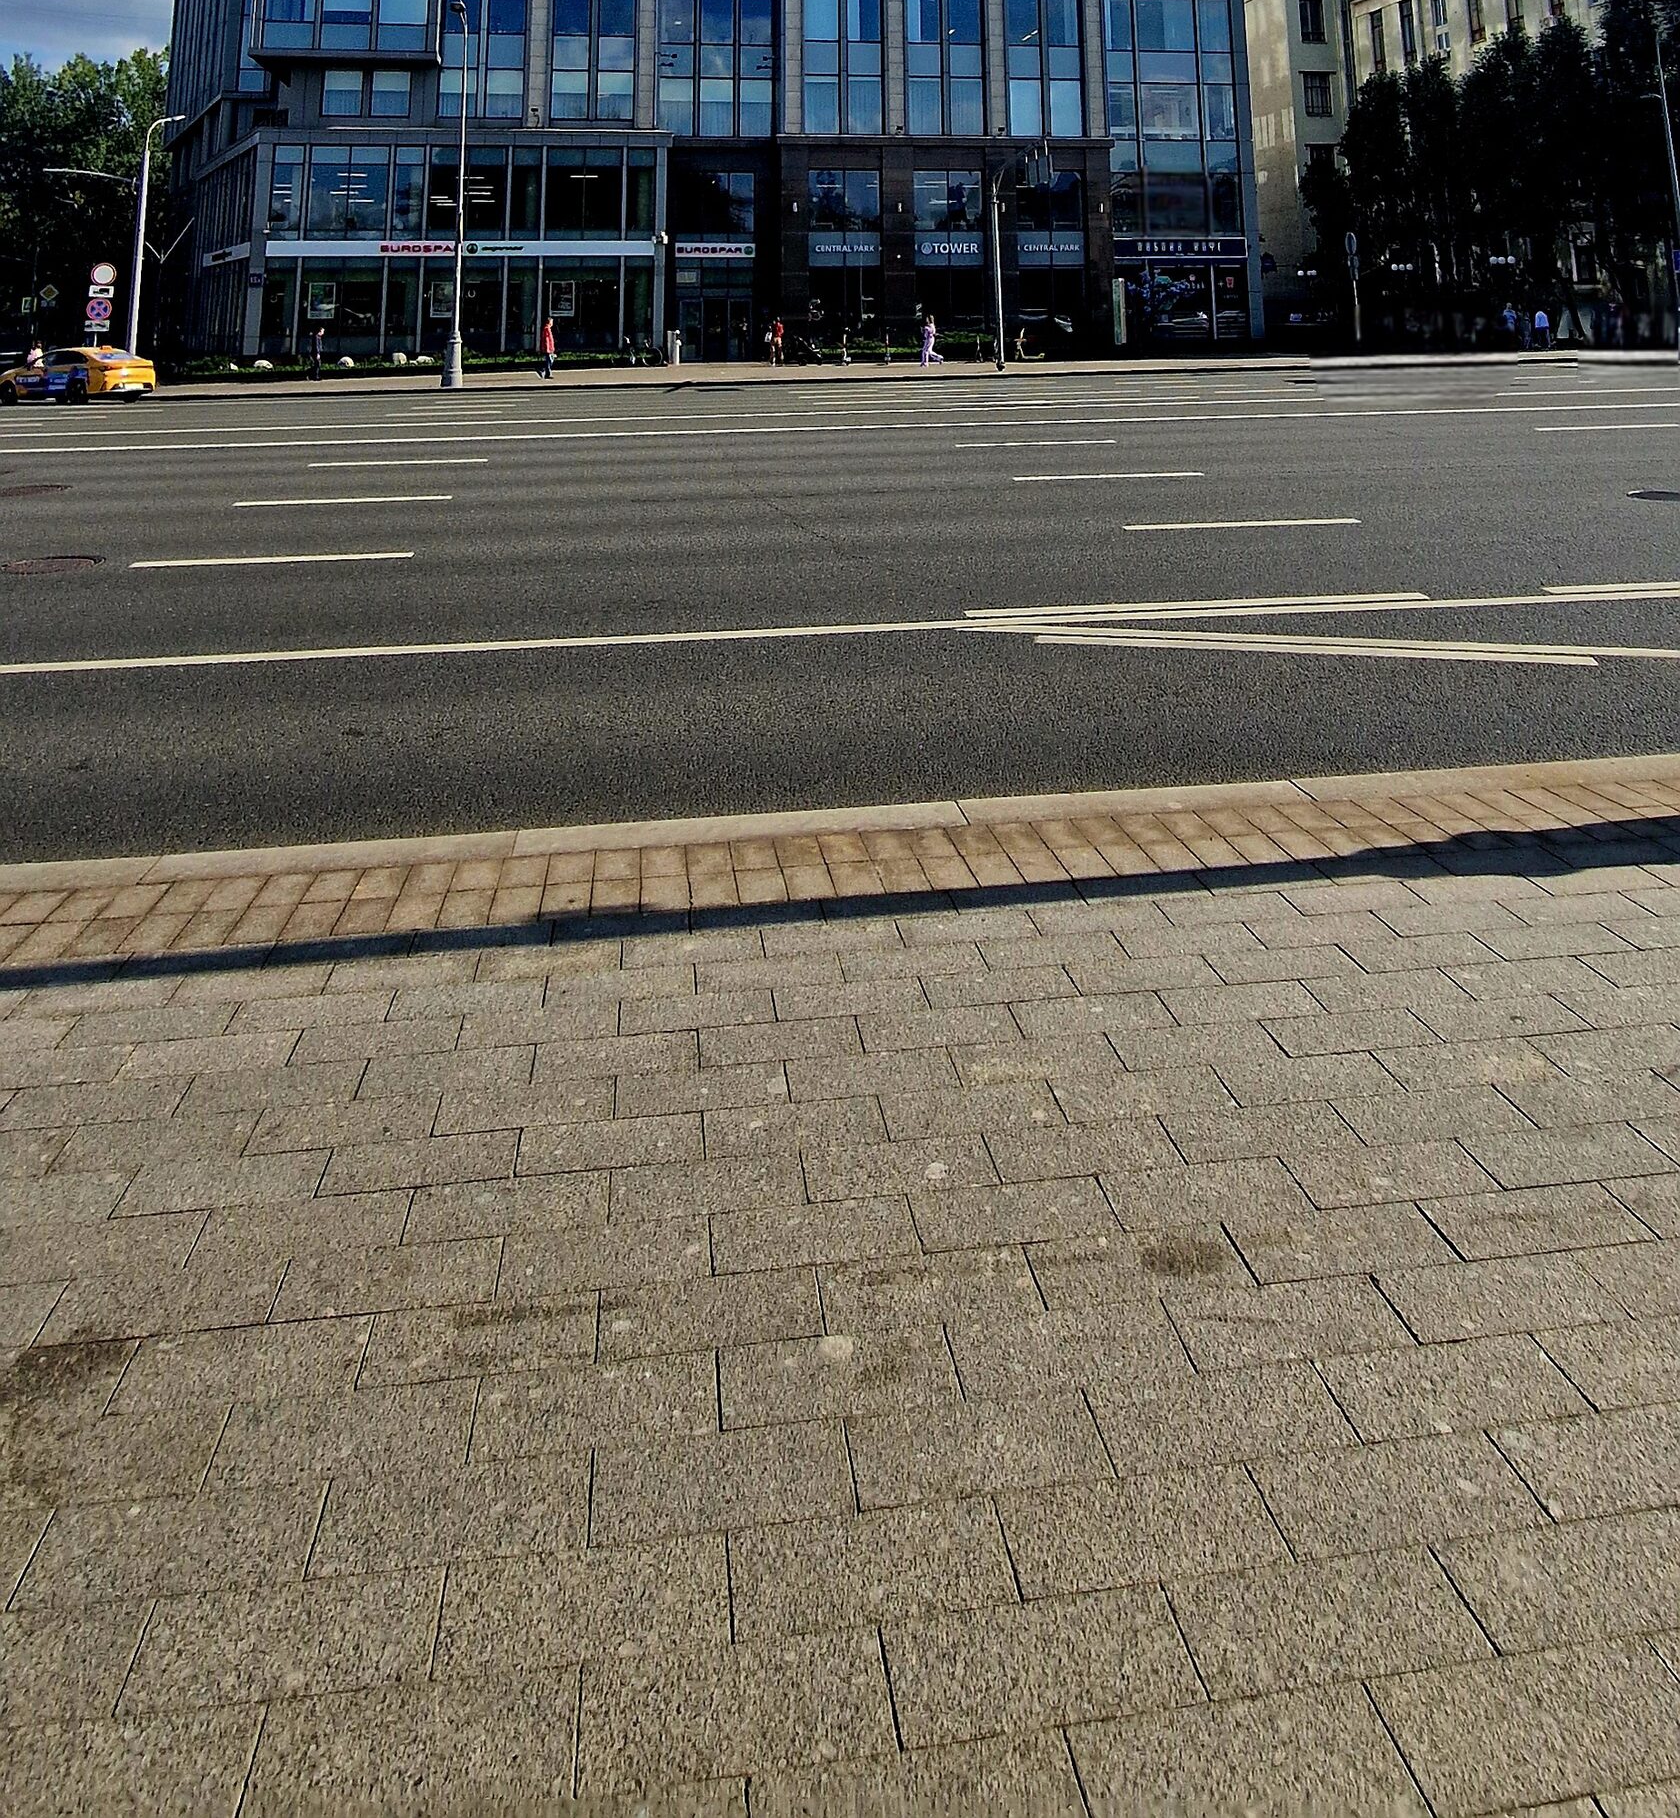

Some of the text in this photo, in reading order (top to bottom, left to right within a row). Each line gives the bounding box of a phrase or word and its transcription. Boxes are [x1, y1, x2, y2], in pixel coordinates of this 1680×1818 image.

[676, 246, 743, 254] EUROSPAR
[932, 243, 979, 254] TOWER
[1023, 244, 1080, 252] CENTRAL PARK
